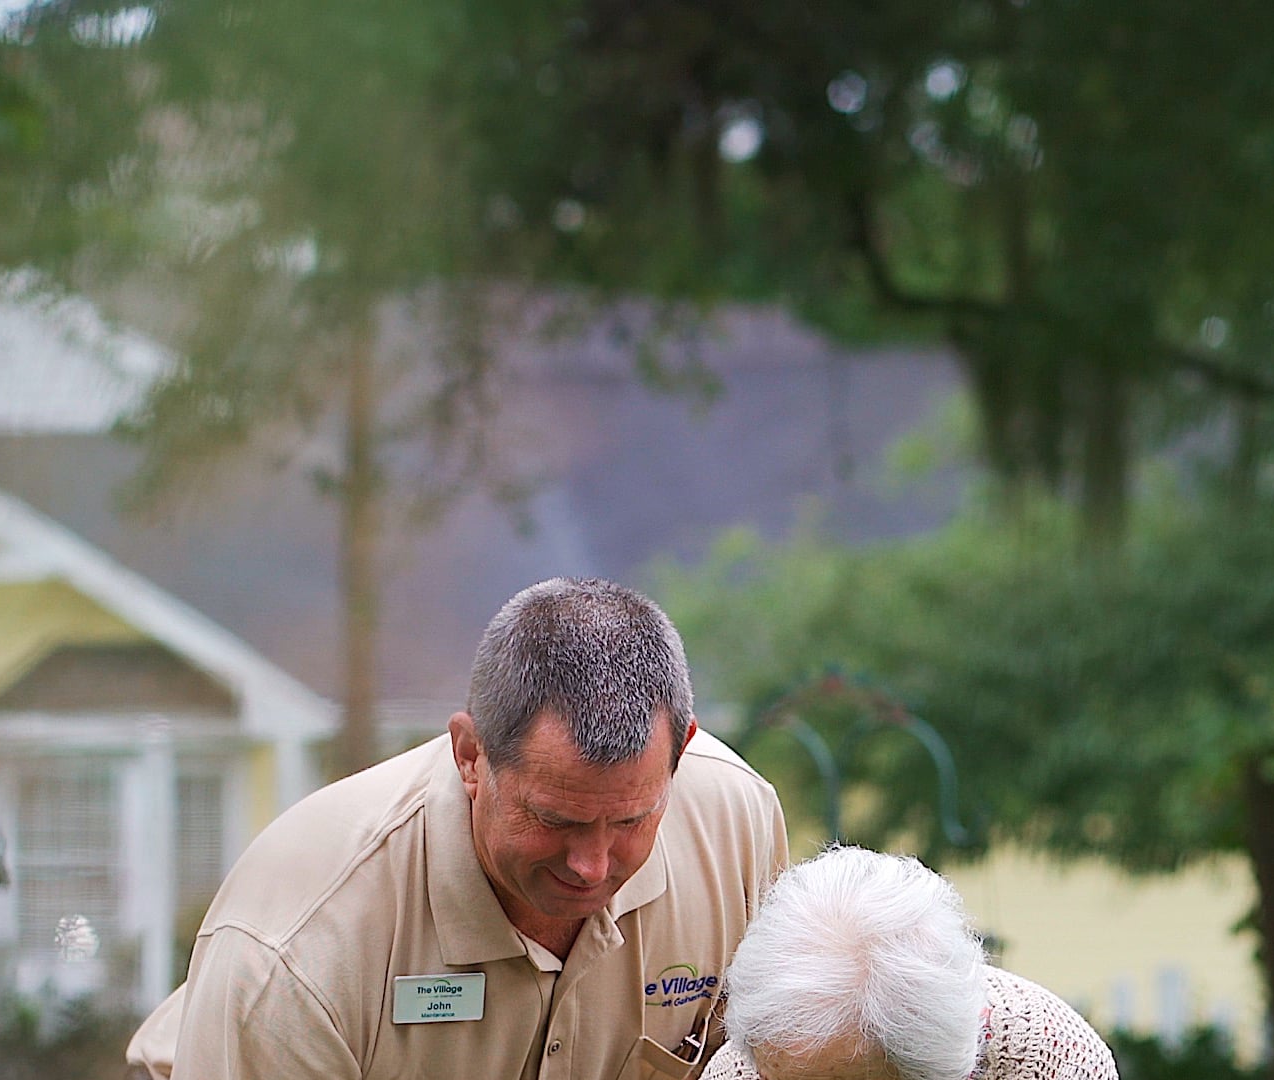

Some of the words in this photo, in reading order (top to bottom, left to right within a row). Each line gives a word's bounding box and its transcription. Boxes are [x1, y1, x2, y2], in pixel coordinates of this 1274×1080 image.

[417, 986, 432, 994] The
[433, 985, 463, 994] Village
[662, 975, 718, 995] Village
[427, 1001, 451, 1010] John
